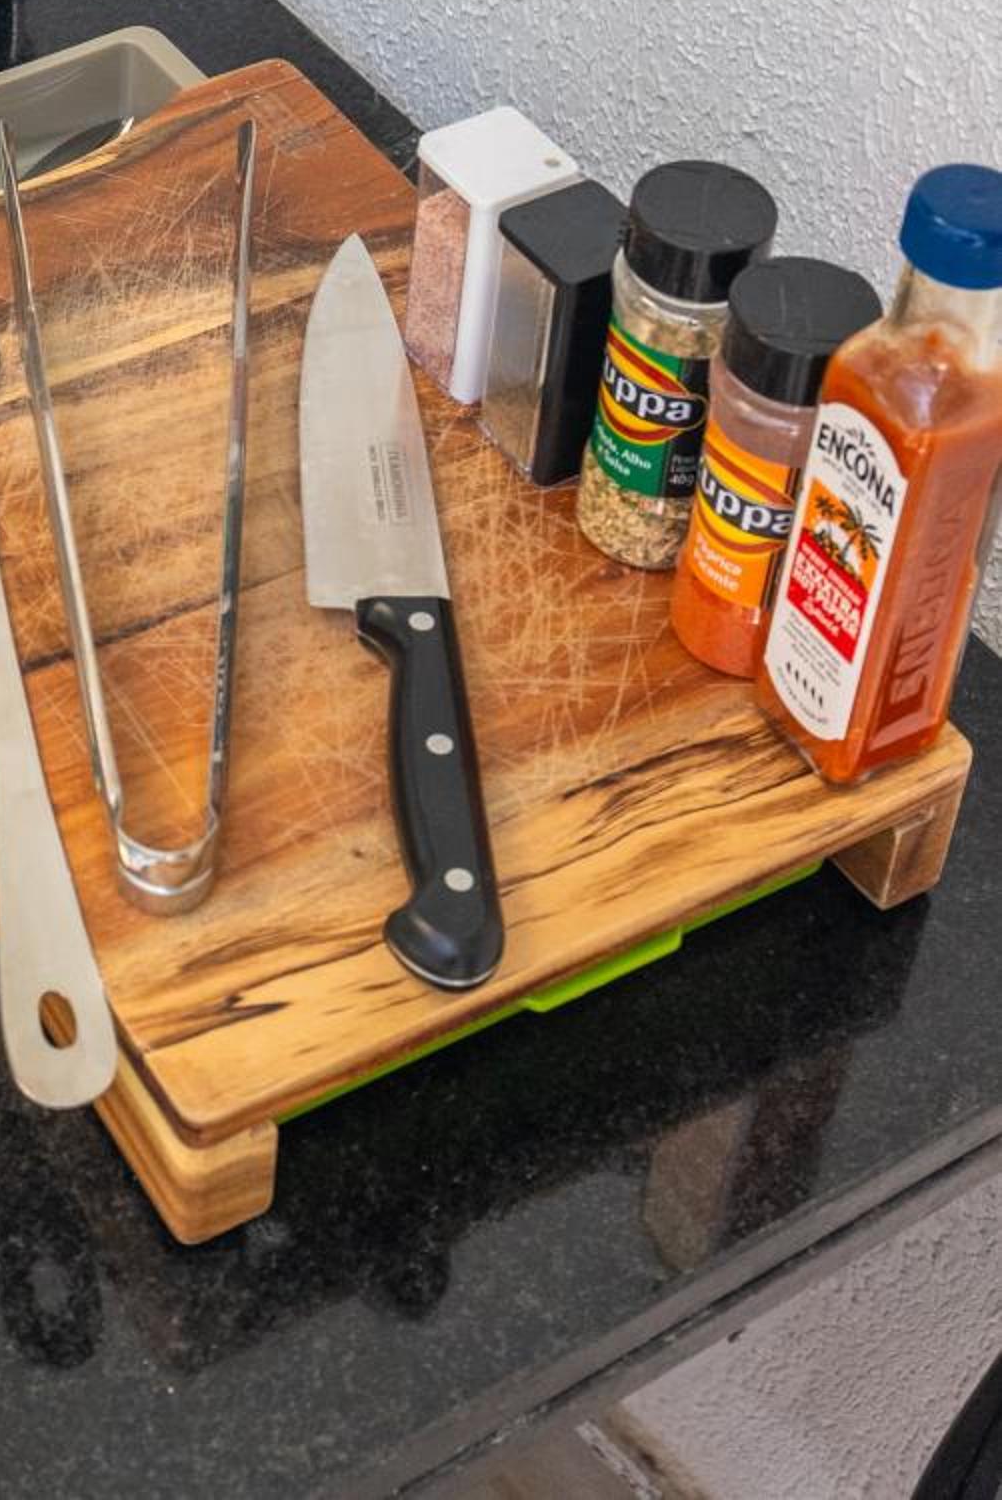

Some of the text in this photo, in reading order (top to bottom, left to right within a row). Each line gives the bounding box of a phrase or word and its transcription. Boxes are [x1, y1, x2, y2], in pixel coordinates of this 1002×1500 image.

[603, 355, 692, 422] uppa
[621, 449, 651, 471] Alho
[700, 457, 794, 534] uppa
[816, 422, 894, 518] ENCONA
